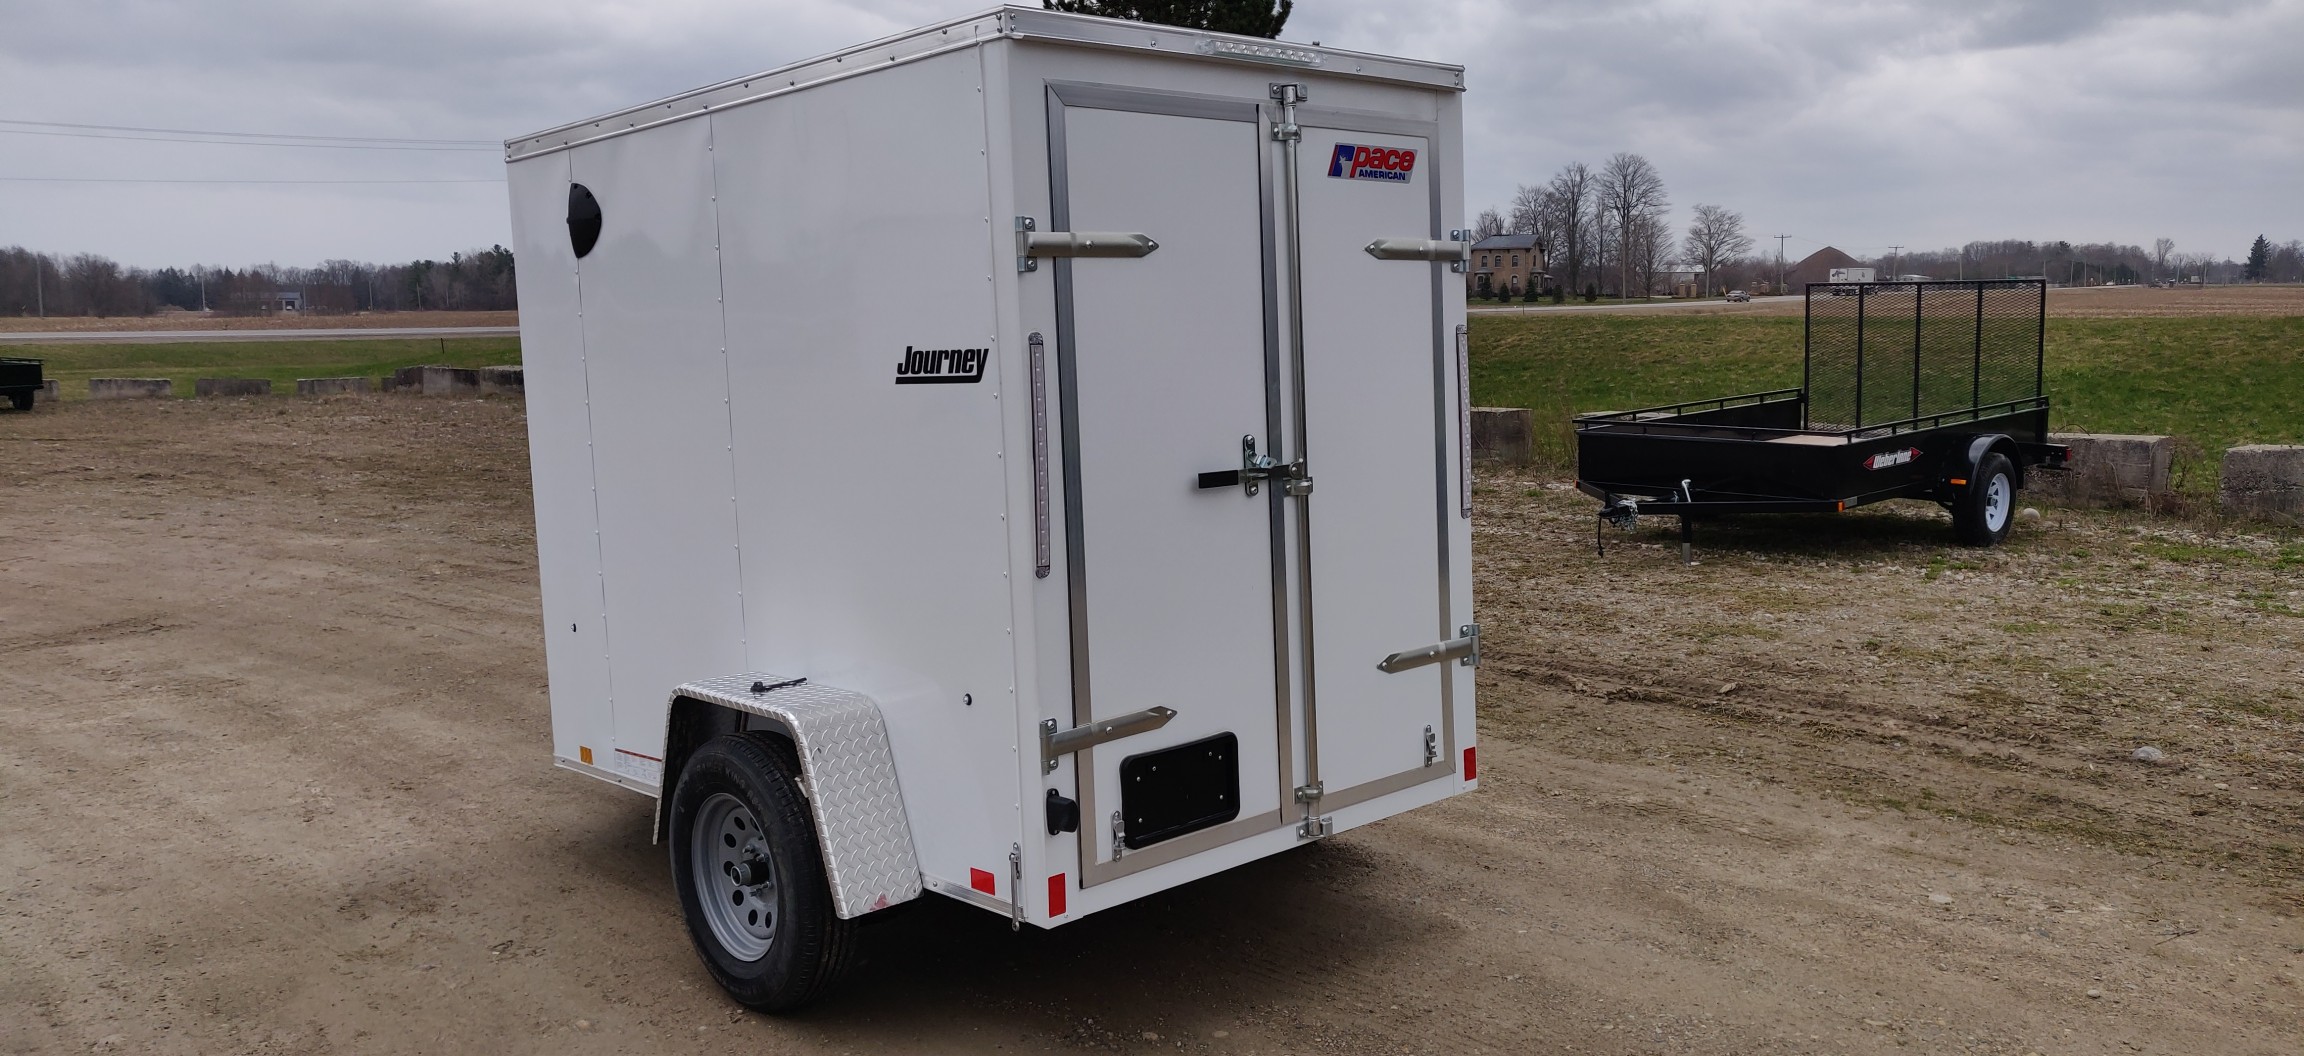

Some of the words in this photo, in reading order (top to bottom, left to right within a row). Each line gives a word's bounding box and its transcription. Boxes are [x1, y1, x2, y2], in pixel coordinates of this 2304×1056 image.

[1349, 146, 1415, 178] pace
[1358, 168, 1406, 180] AMERICAN
[895, 345, 989, 384] Journey
